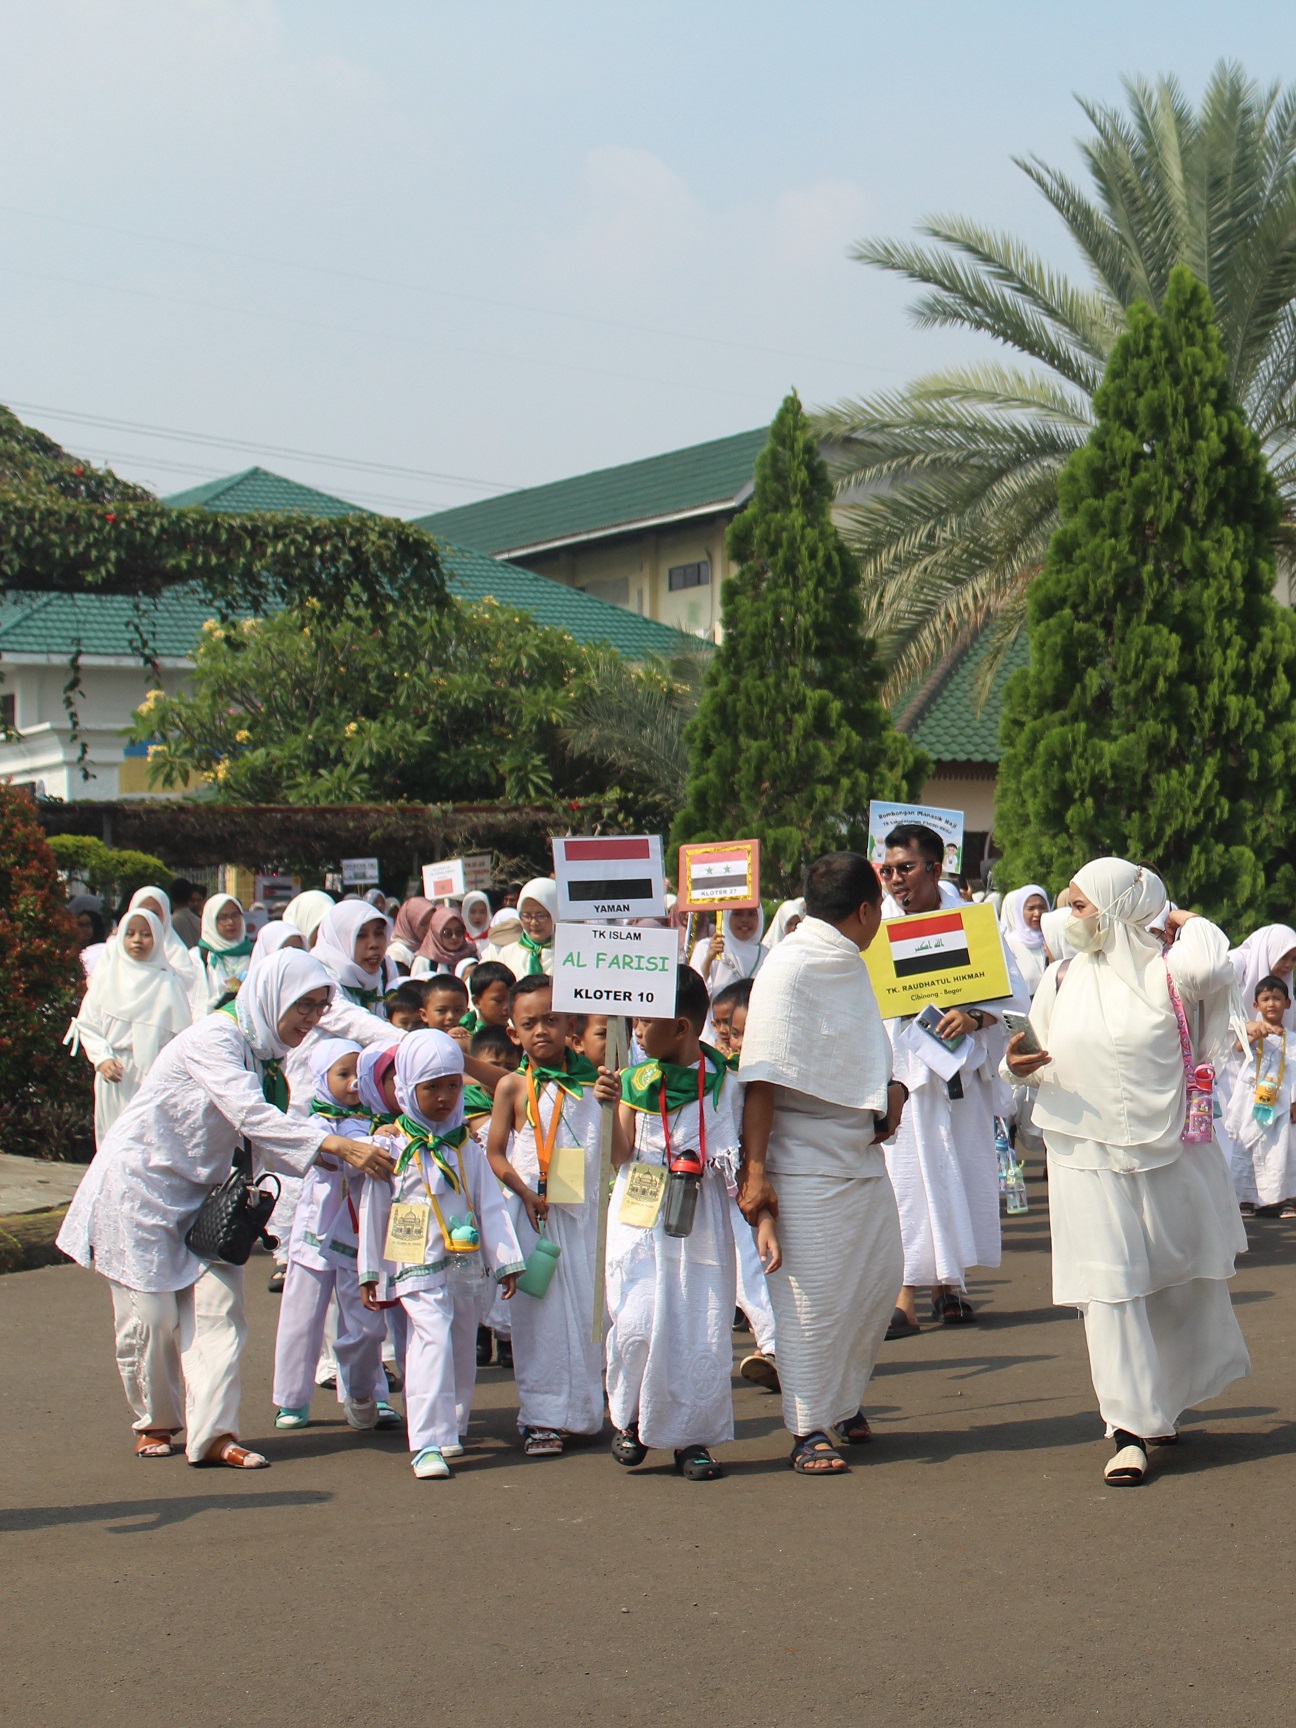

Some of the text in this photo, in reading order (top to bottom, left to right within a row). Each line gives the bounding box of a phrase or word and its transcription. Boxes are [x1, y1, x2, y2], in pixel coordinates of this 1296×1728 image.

[594, 904, 630, 913] YAMAN
[592, 929, 641, 941] TK ISLAM
[562, 951, 669, 972] AL FARISI
[886, 971, 985, 995] TK. RAUDHATUL HIKMAH
[573, 988, 654, 1003] KLOTER 10
[910, 991, 939, 1002] Cibinong
[943, 987, 963, 998] Bogor
